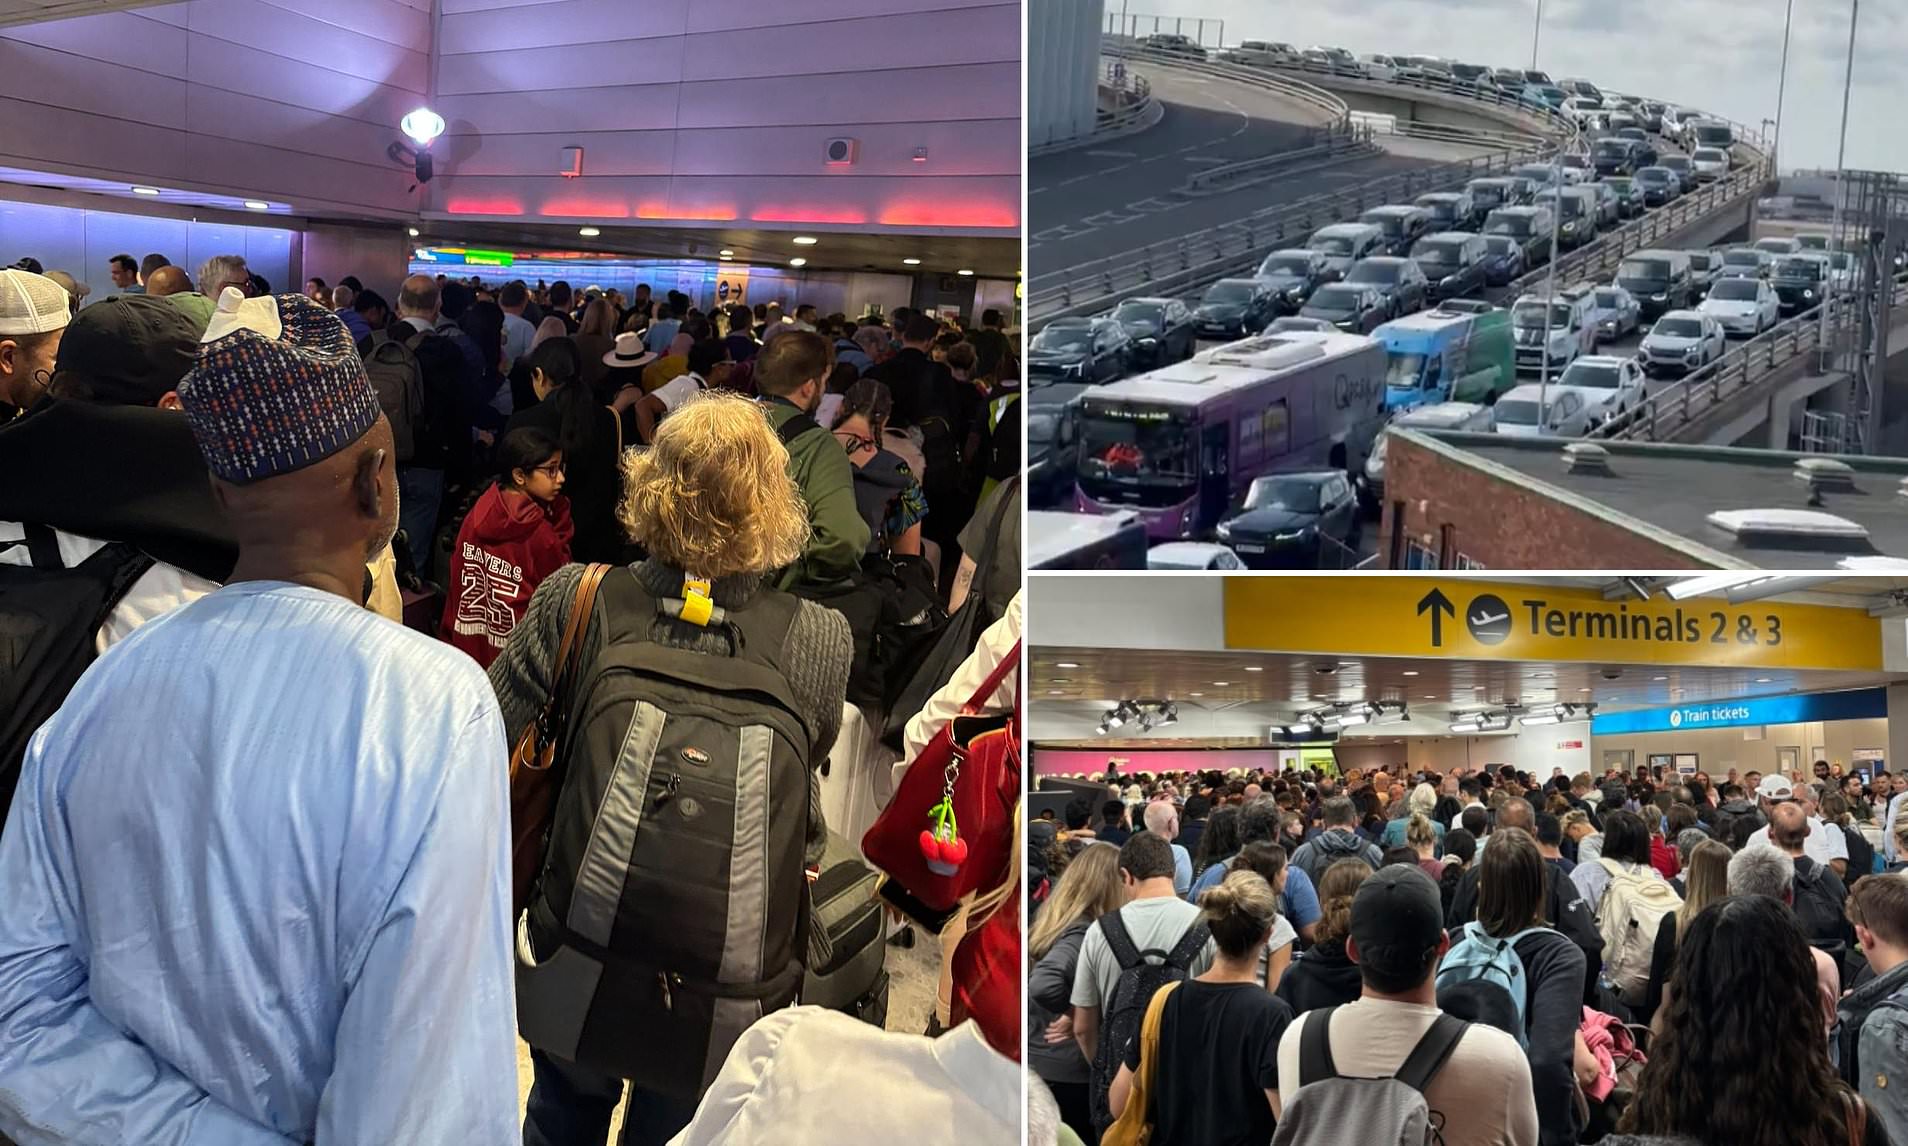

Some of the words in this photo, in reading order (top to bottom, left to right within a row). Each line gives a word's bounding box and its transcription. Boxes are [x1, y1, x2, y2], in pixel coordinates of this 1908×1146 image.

[458, 562, 519, 636] 25
[1523, 600, 1700, 642] Terminals
[1710, 611, 1728, 644] 2
[1736, 614, 1758, 646] &
[1766, 615, 1782, 646] 3
[1683, 708, 1710, 722] Train
[1712, 706, 1750, 720] tickets
